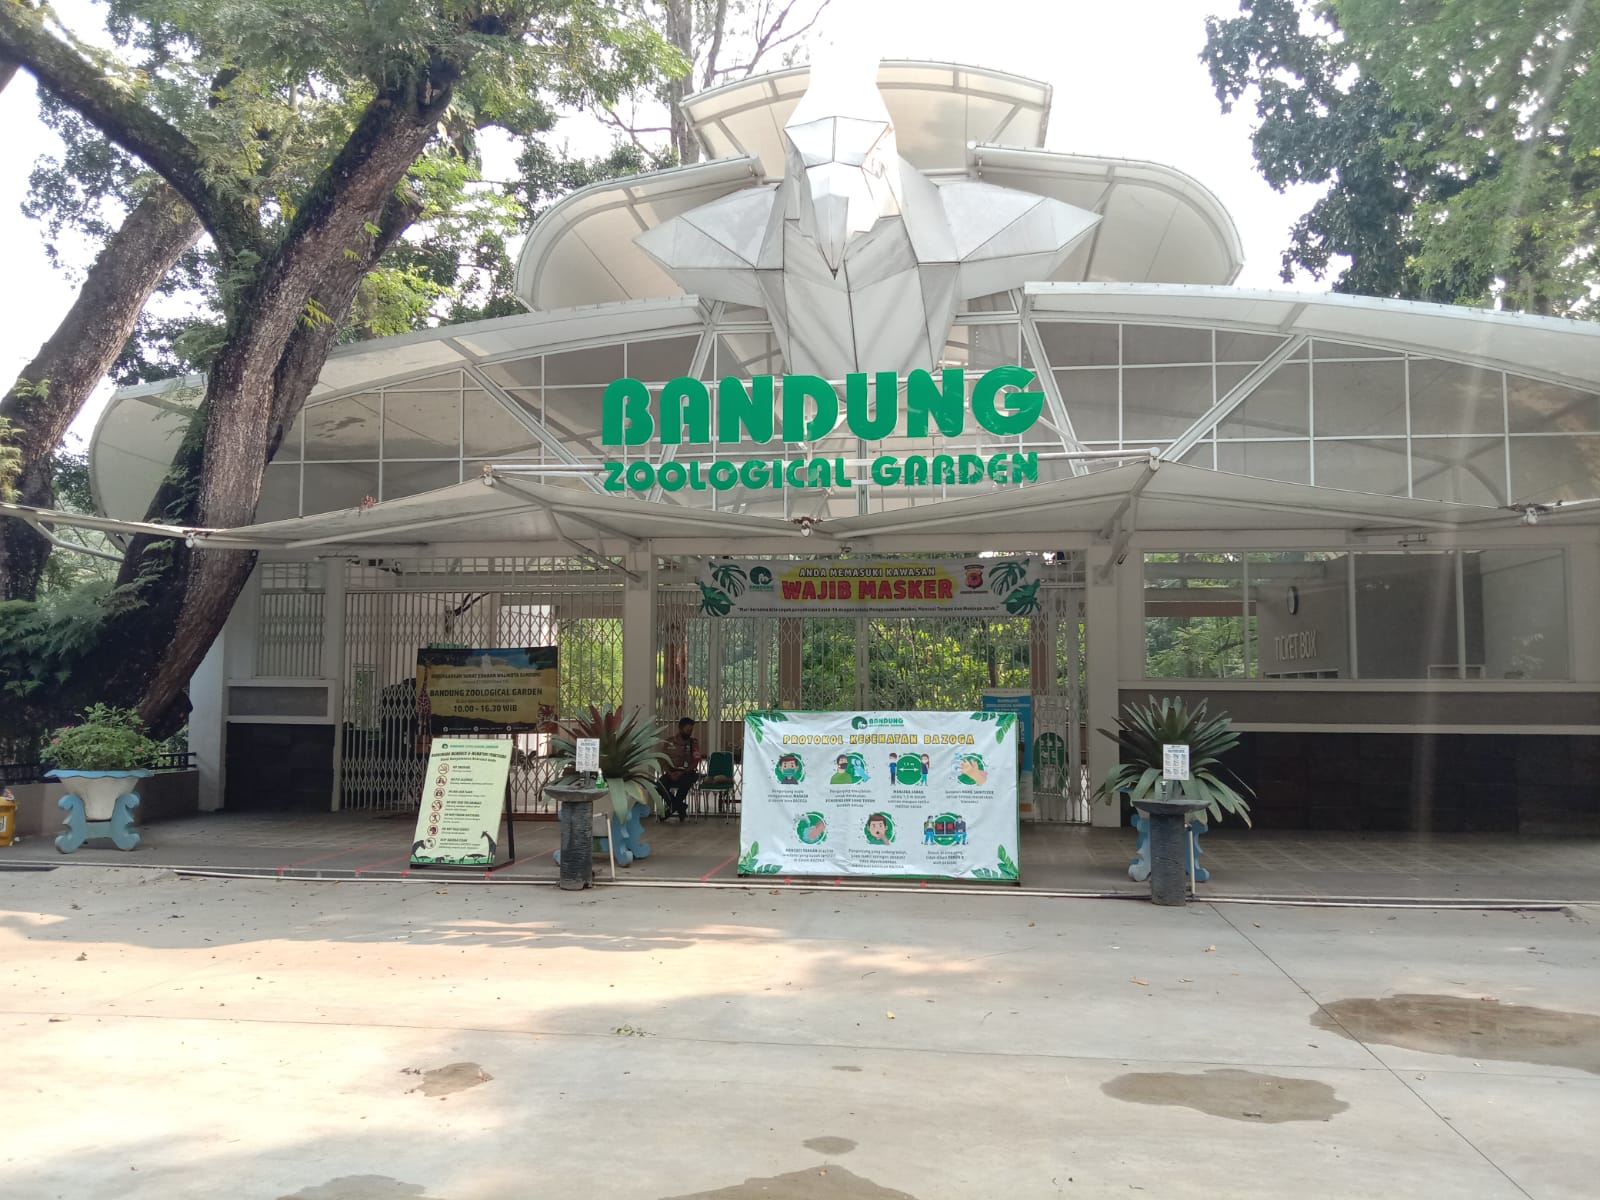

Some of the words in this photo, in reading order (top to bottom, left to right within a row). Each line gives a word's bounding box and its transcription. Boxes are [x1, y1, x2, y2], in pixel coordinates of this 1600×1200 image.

[602, 366, 1045, 446] BANDUNG
[603, 457, 852, 491] ZOOLOGICAL
[871, 451, 1038, 487] GARDEN
[799, 568, 827, 577] ANDA
[829, 568, 883, 577] MEMASUKI
[885, 567, 936, 577] KAWASAN
[782, 580, 852, 600] WAJIB
[858, 579, 954, 600] MASKER
[1274, 633, 1298, 661] TICKET
[1300, 630, 1317, 658] BOX
[429, 688, 464, 697] BANDUNG
[465, 688, 510, 697] ZOOLOGICAL
[512, 687, 543, 696] GARDEN
[453, 705, 474, 713] 10.00
[502, 704, 517, 712] WIB
[783, 734, 843, 745] PROTOKOL
[850, 734, 918, 745] KESEHATAN
[924, 734, 975, 745] BAZOGA
